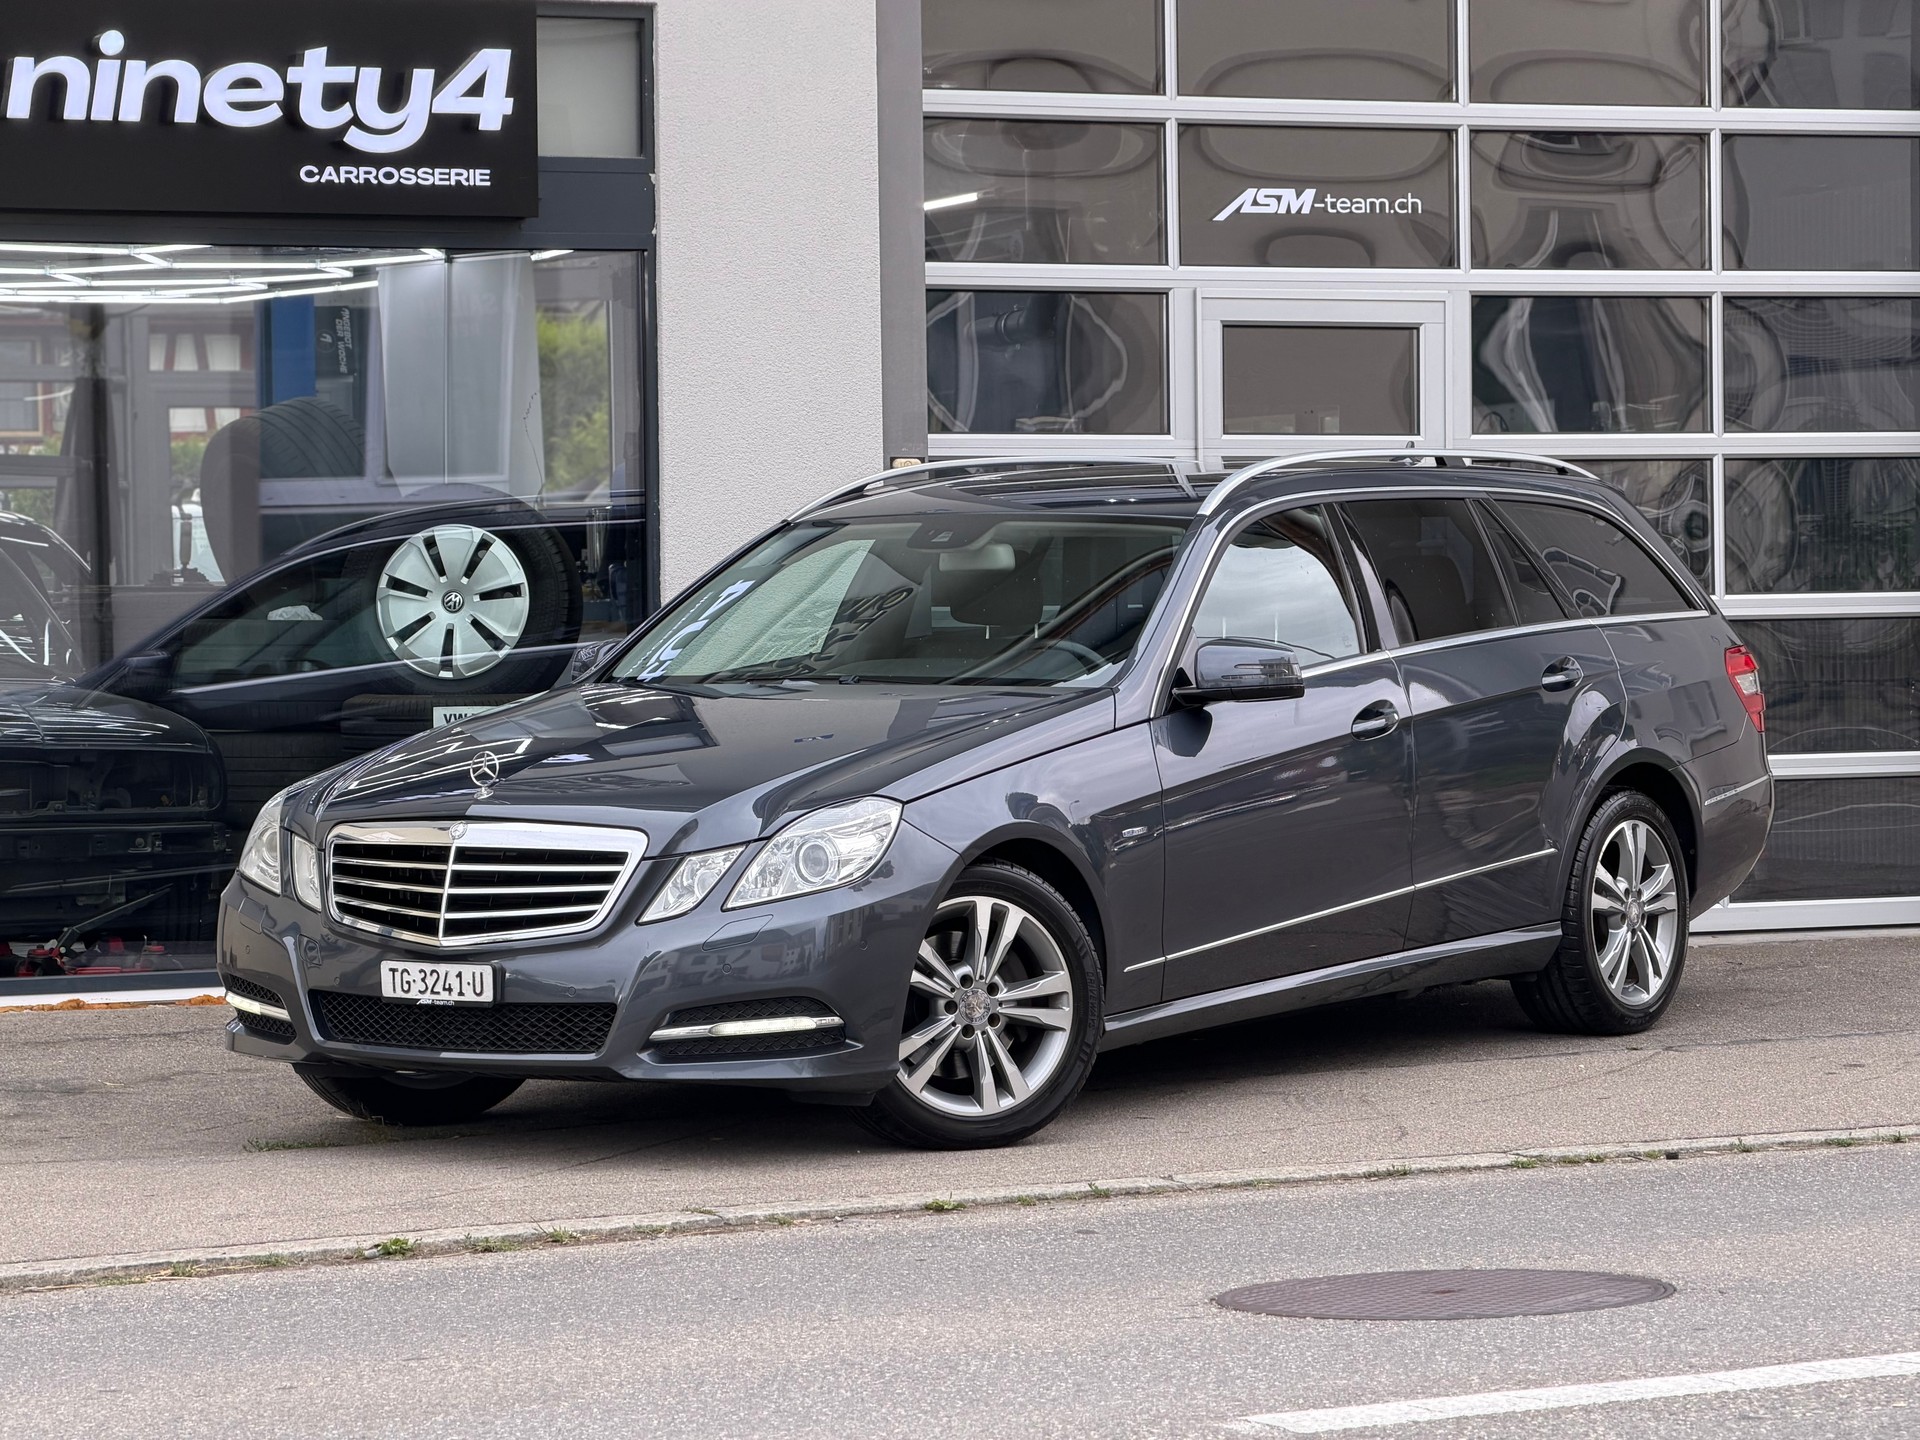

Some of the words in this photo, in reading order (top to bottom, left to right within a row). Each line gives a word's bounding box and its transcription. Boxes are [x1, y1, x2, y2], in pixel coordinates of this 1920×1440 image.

[6, 29, 514, 153] ninety4
[300, 165, 492, 187] CARROSSERIE
[1212, 187, 1423, 222] ASM-team.ch
[335, 318, 344, 337] DER
[340, 307, 353, 350] ANGEBOT
[337, 341, 348, 374] WOCHE
